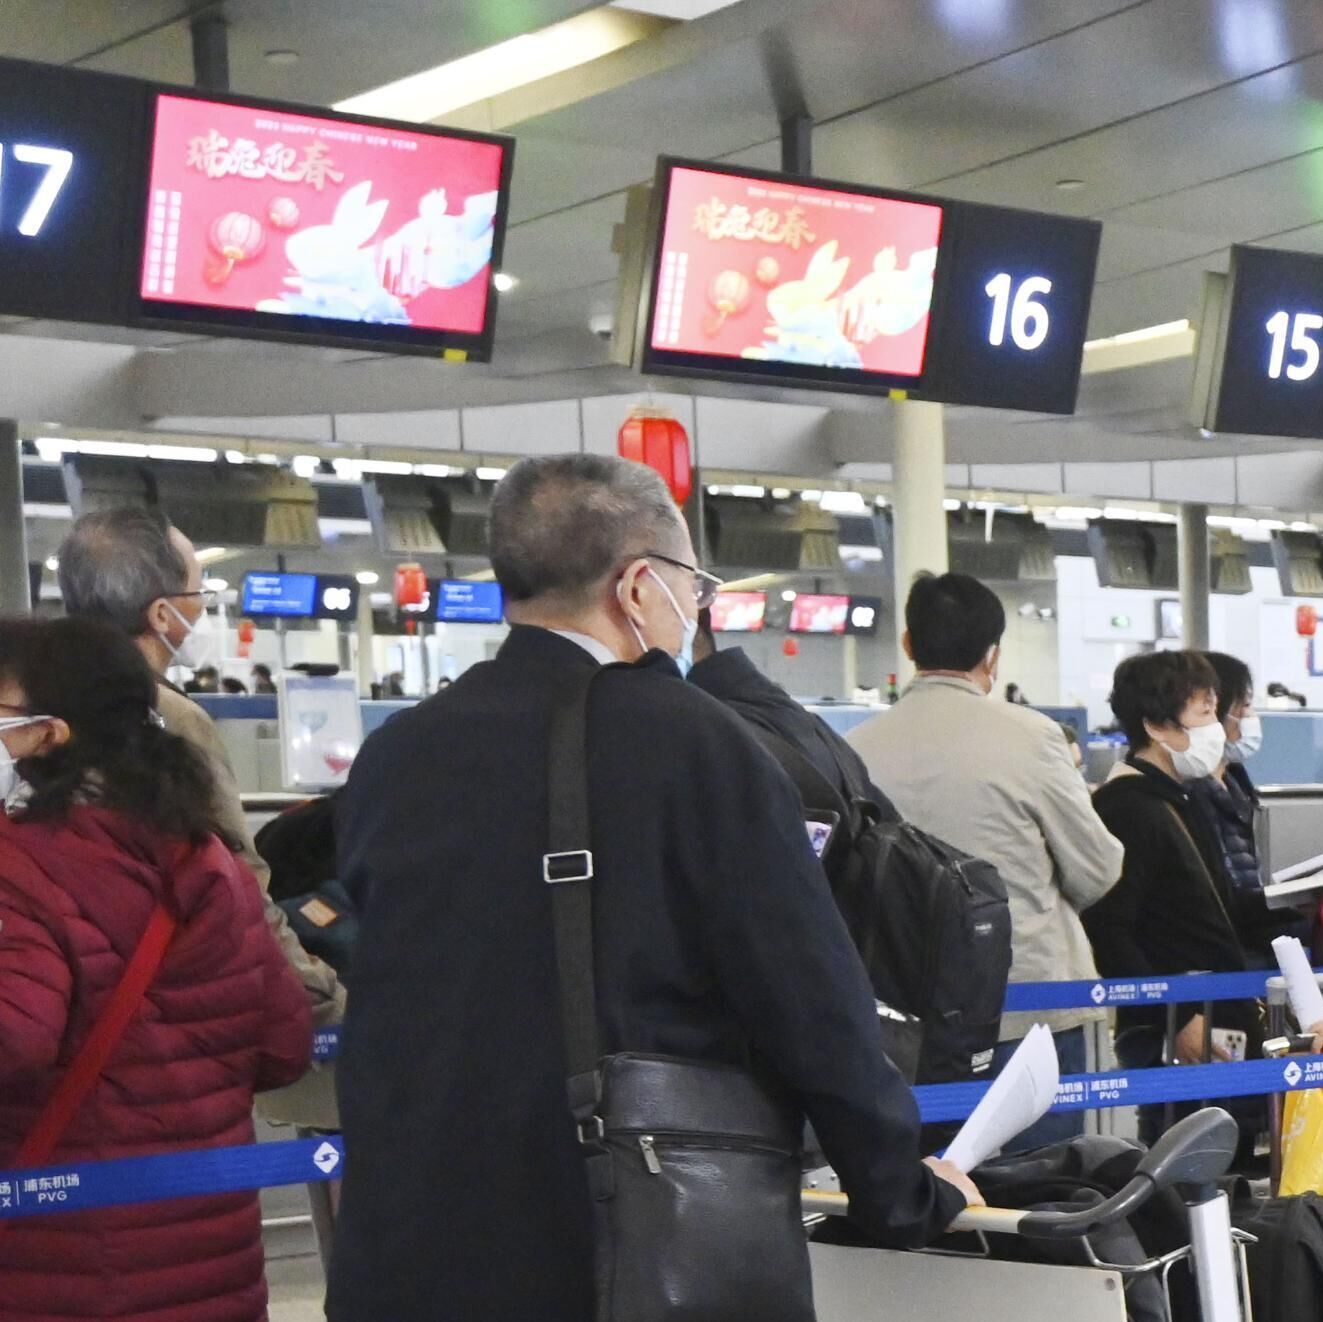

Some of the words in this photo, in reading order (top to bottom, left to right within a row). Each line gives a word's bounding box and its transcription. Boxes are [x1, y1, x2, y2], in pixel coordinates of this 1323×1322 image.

[0, 143, 73, 237] 7
[984, 273, 1052, 351] 16
[1265, 311, 1323, 381] 15
[1100, 1090, 1119, 1100] PVG
[24, 1173, 80, 1192] 浦东机场
[38, 1190, 67, 1203] PVG
